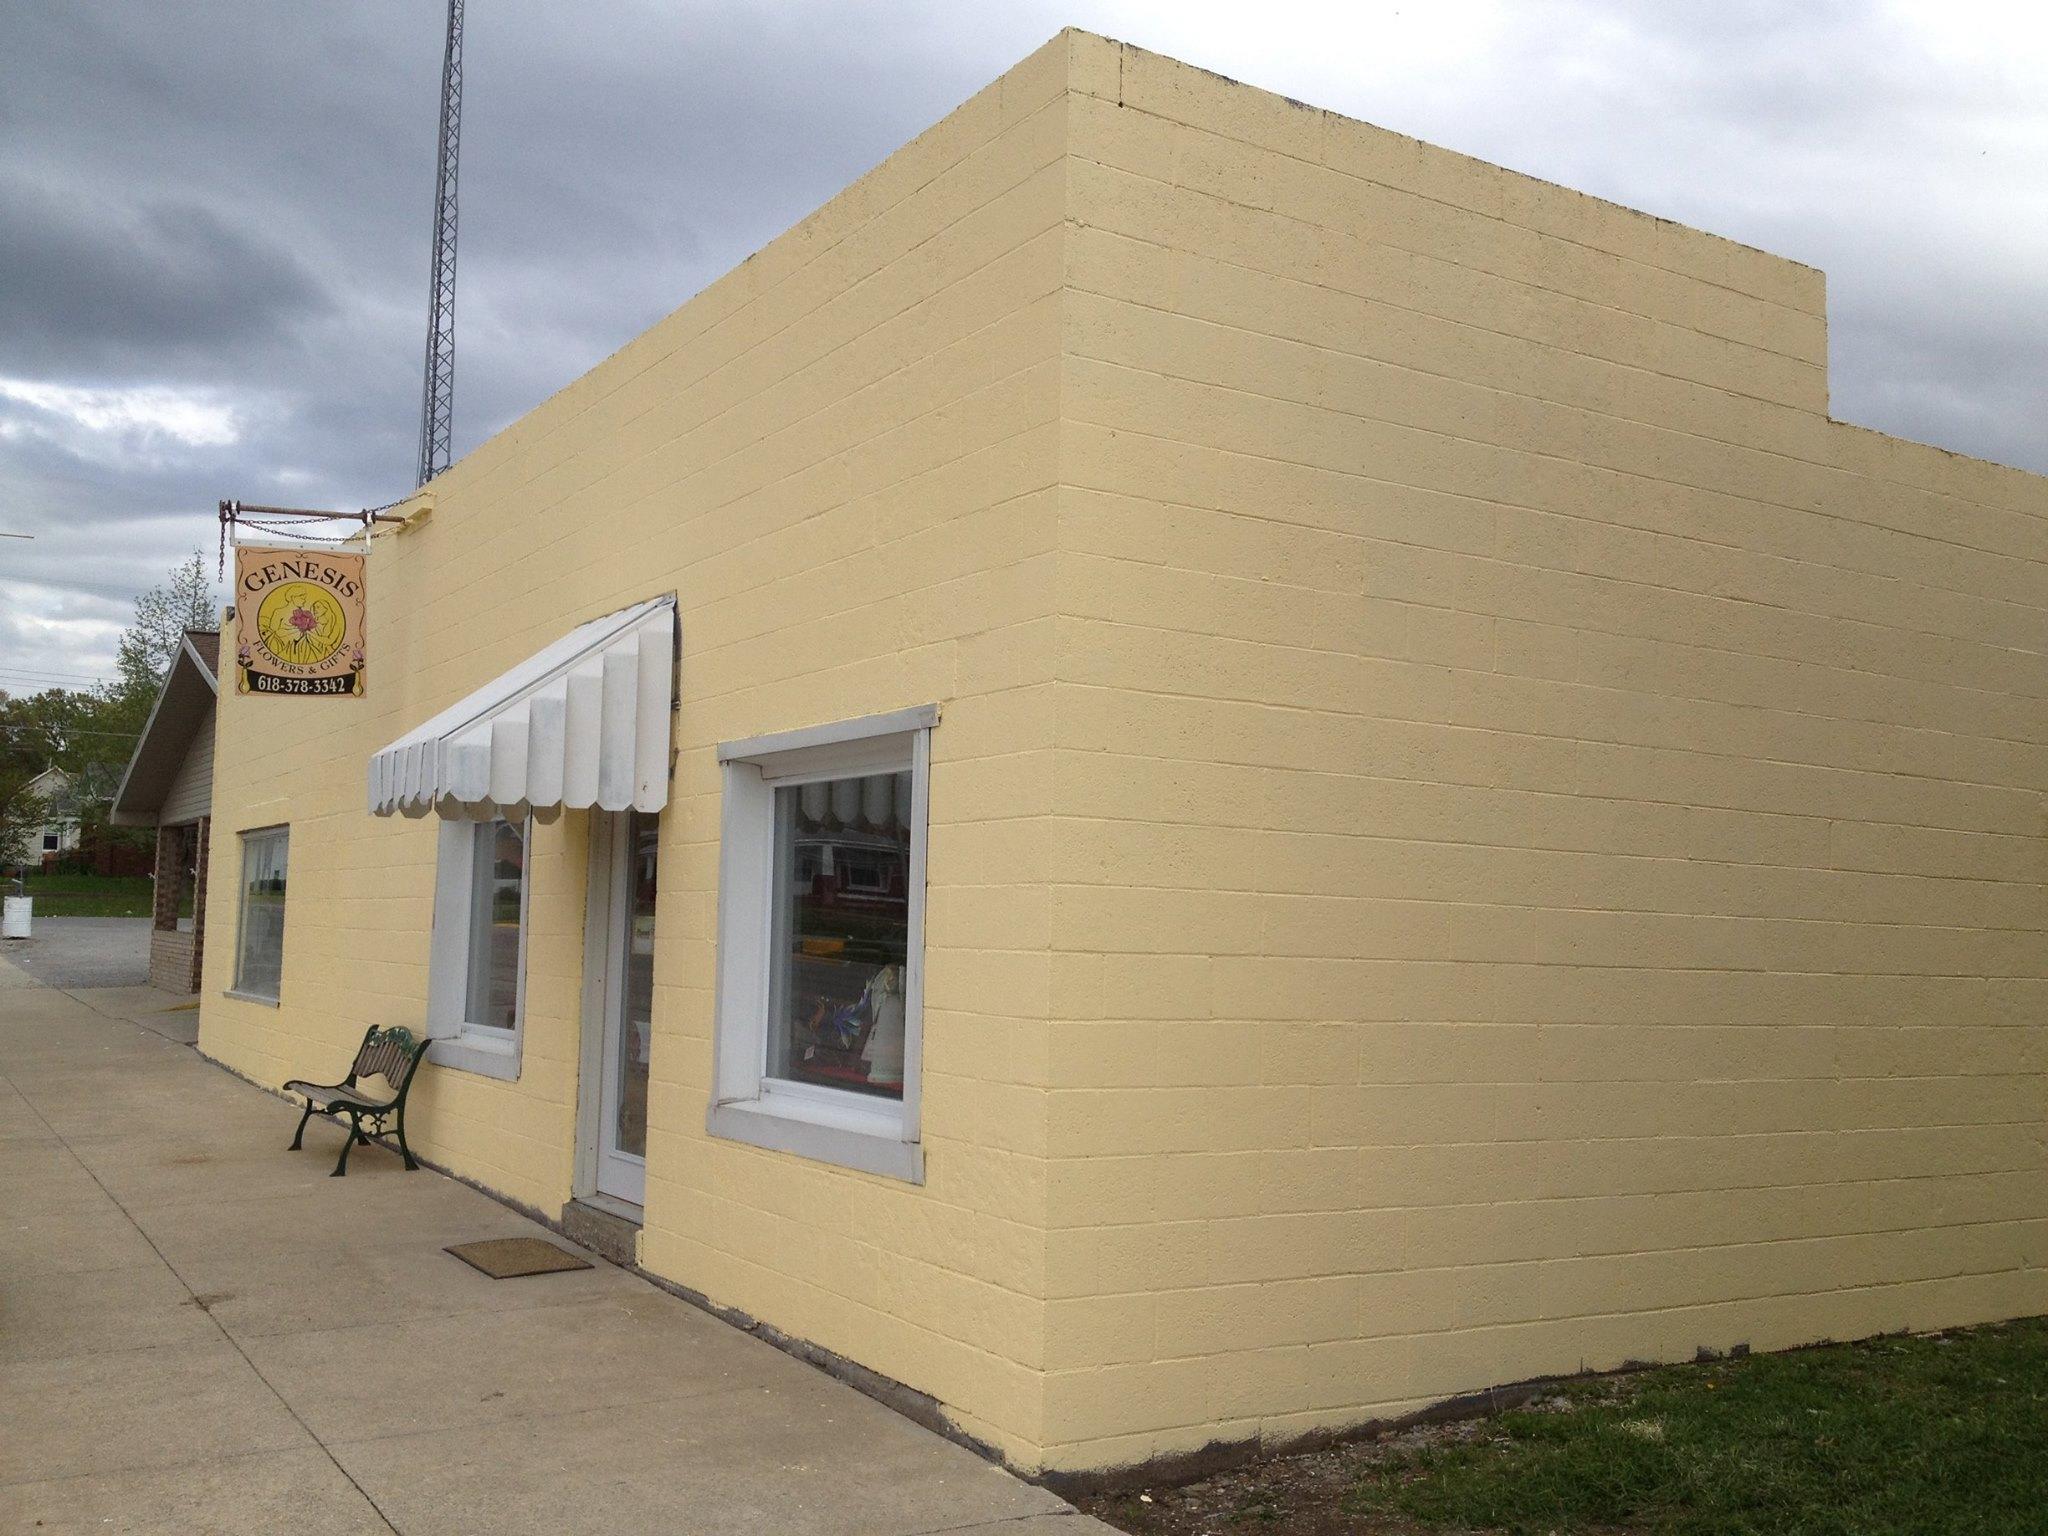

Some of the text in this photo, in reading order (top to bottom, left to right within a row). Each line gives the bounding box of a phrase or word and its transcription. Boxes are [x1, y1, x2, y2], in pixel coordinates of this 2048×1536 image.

[244, 561, 359, 597] GENESIS
[253, 640, 350, 674] FLOWERS & GIFTS
[258, 675, 345, 693] 618-378-3342
